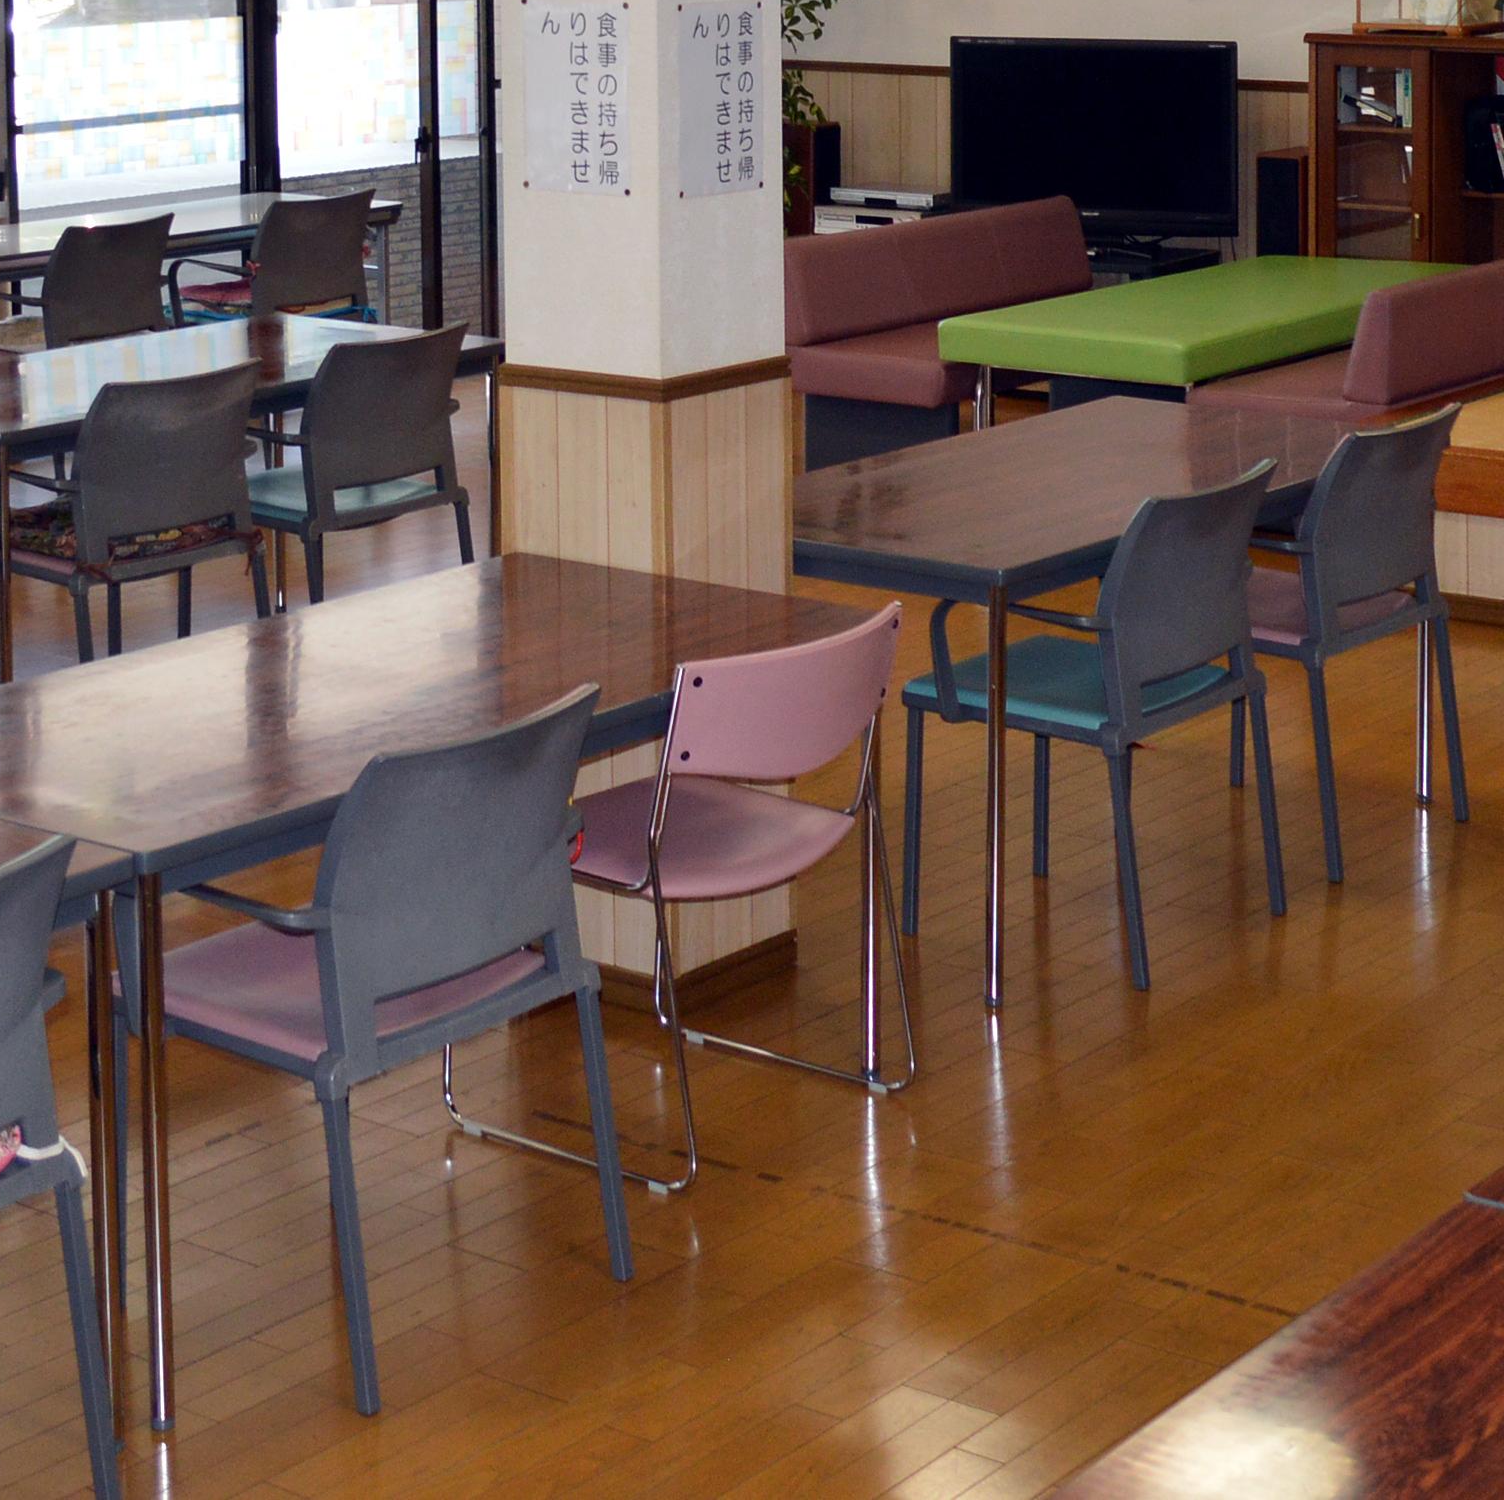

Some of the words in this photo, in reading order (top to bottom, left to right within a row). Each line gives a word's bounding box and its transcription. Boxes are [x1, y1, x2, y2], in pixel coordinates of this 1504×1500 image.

[541, 11, 561, 35] ん
[569, 11, 591, 184] りはできませ
[596, 12, 620, 186] 食事の持ち帰
[692, 15, 709, 39] ん
[715, 13, 732, 183] りはできませ
[737, 11, 754, 181] 食事の持ち帰
